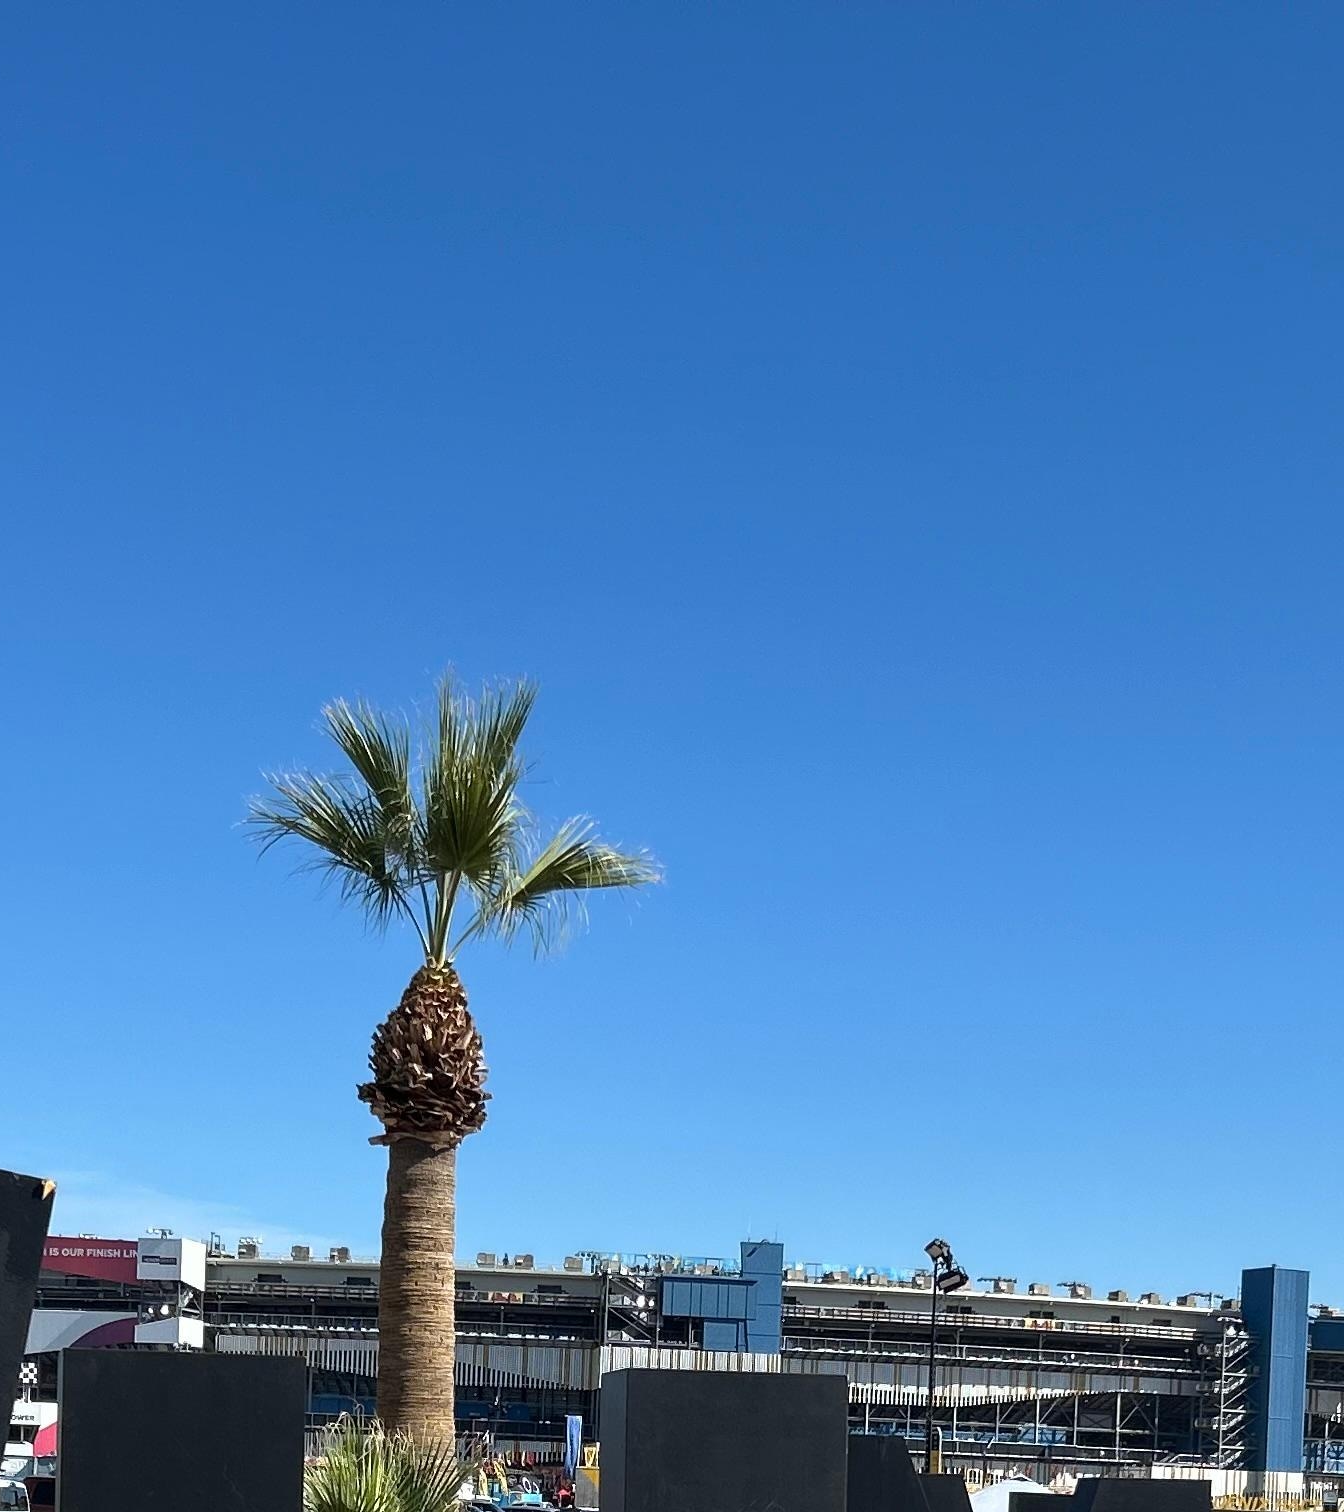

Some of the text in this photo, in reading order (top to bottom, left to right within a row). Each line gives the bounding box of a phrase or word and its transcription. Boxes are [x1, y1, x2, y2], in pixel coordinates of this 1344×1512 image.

[49, 1247, 59, 1257] IS
[61, 1248, 84, 1257] OUR
[86, 1248, 121, 1258] FINISH
